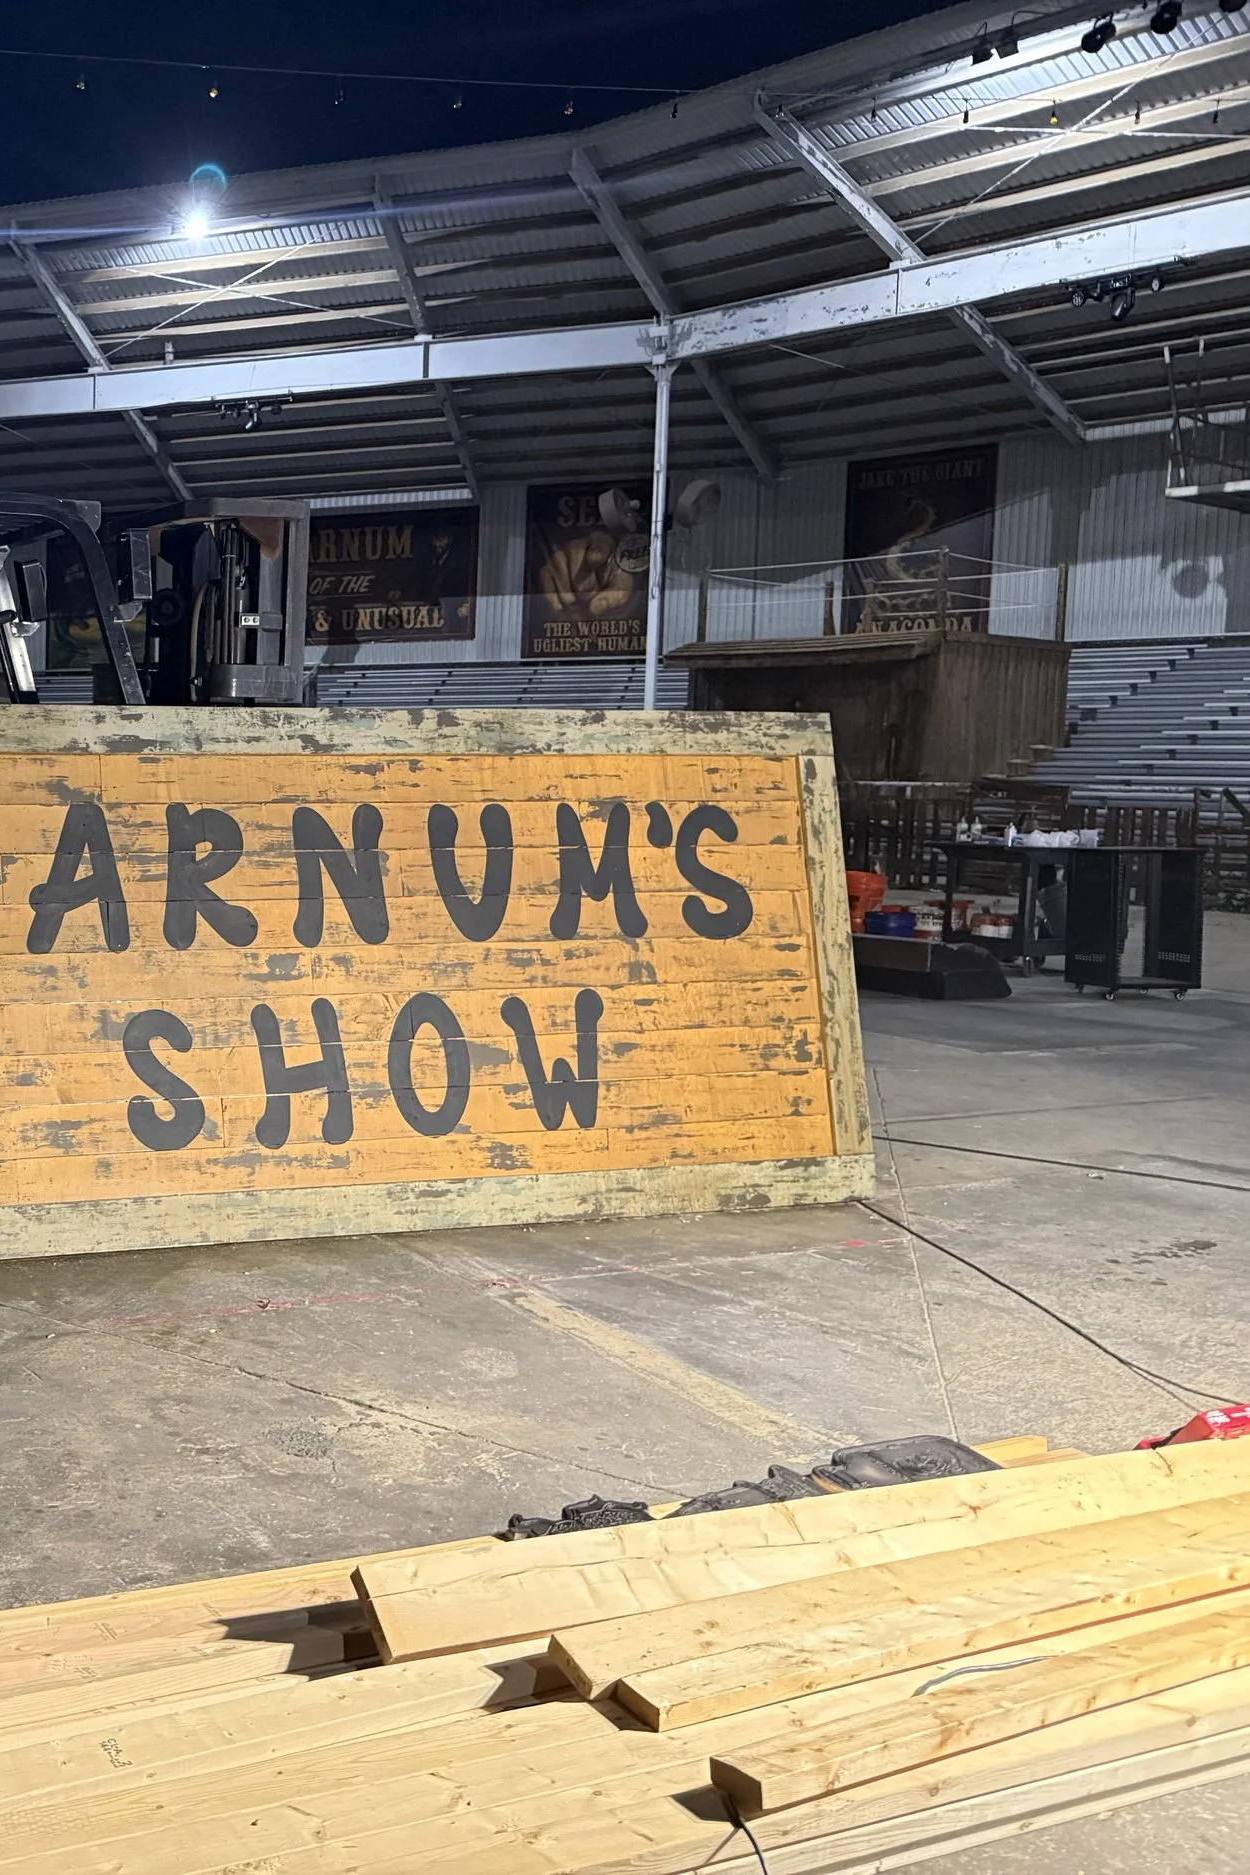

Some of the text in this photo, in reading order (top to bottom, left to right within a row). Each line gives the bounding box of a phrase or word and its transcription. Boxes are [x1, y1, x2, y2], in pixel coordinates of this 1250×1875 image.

[309, 575, 375, 595] OF THE
[313, 605, 445, 632] & UNUSUAL
[543, 620, 641, 637] THE WORLD'S
[533, 638, 592, 653] UGLIEST
[123, 988, 603, 1151] SHOW
